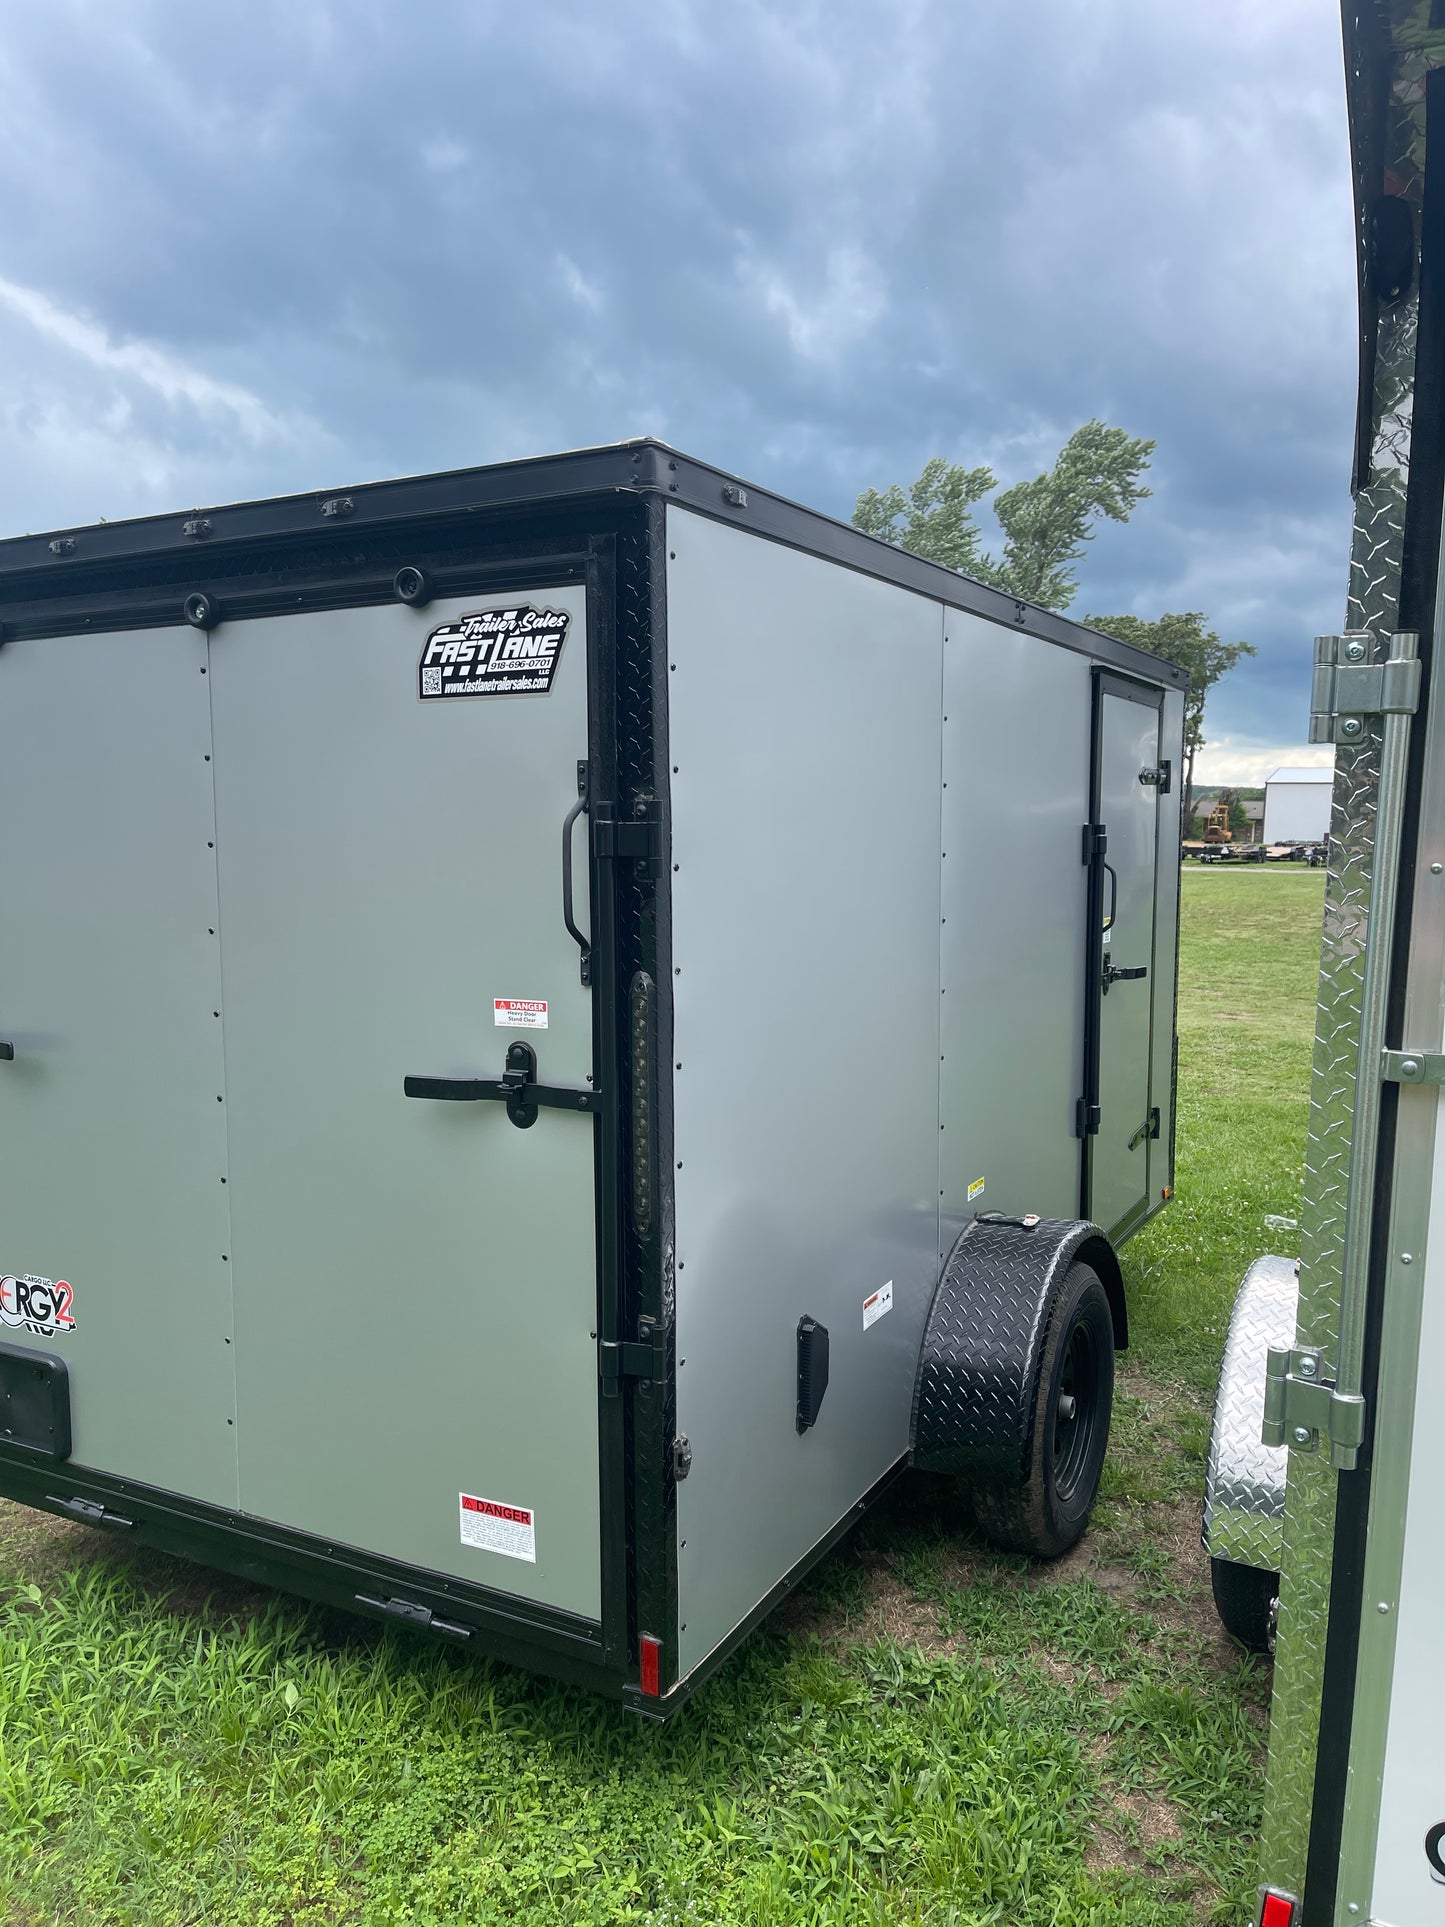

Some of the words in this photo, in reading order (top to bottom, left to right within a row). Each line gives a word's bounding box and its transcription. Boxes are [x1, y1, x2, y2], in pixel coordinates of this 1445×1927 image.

[463, 616, 520, 637] Trailer
[520, 611, 567, 632] Sales
[424, 634, 495, 665] FAST
[489, 633, 560, 667] LANE
[490, 658, 551, 671] 918-696-0701
[444, 675, 549, 694] www.fastlanetrailersales.com
[509, 1002, 544, 1011] DANGER
[24, 1275, 42, 1284] CARGO
[476, 1500, 529, 1523] DANGER
